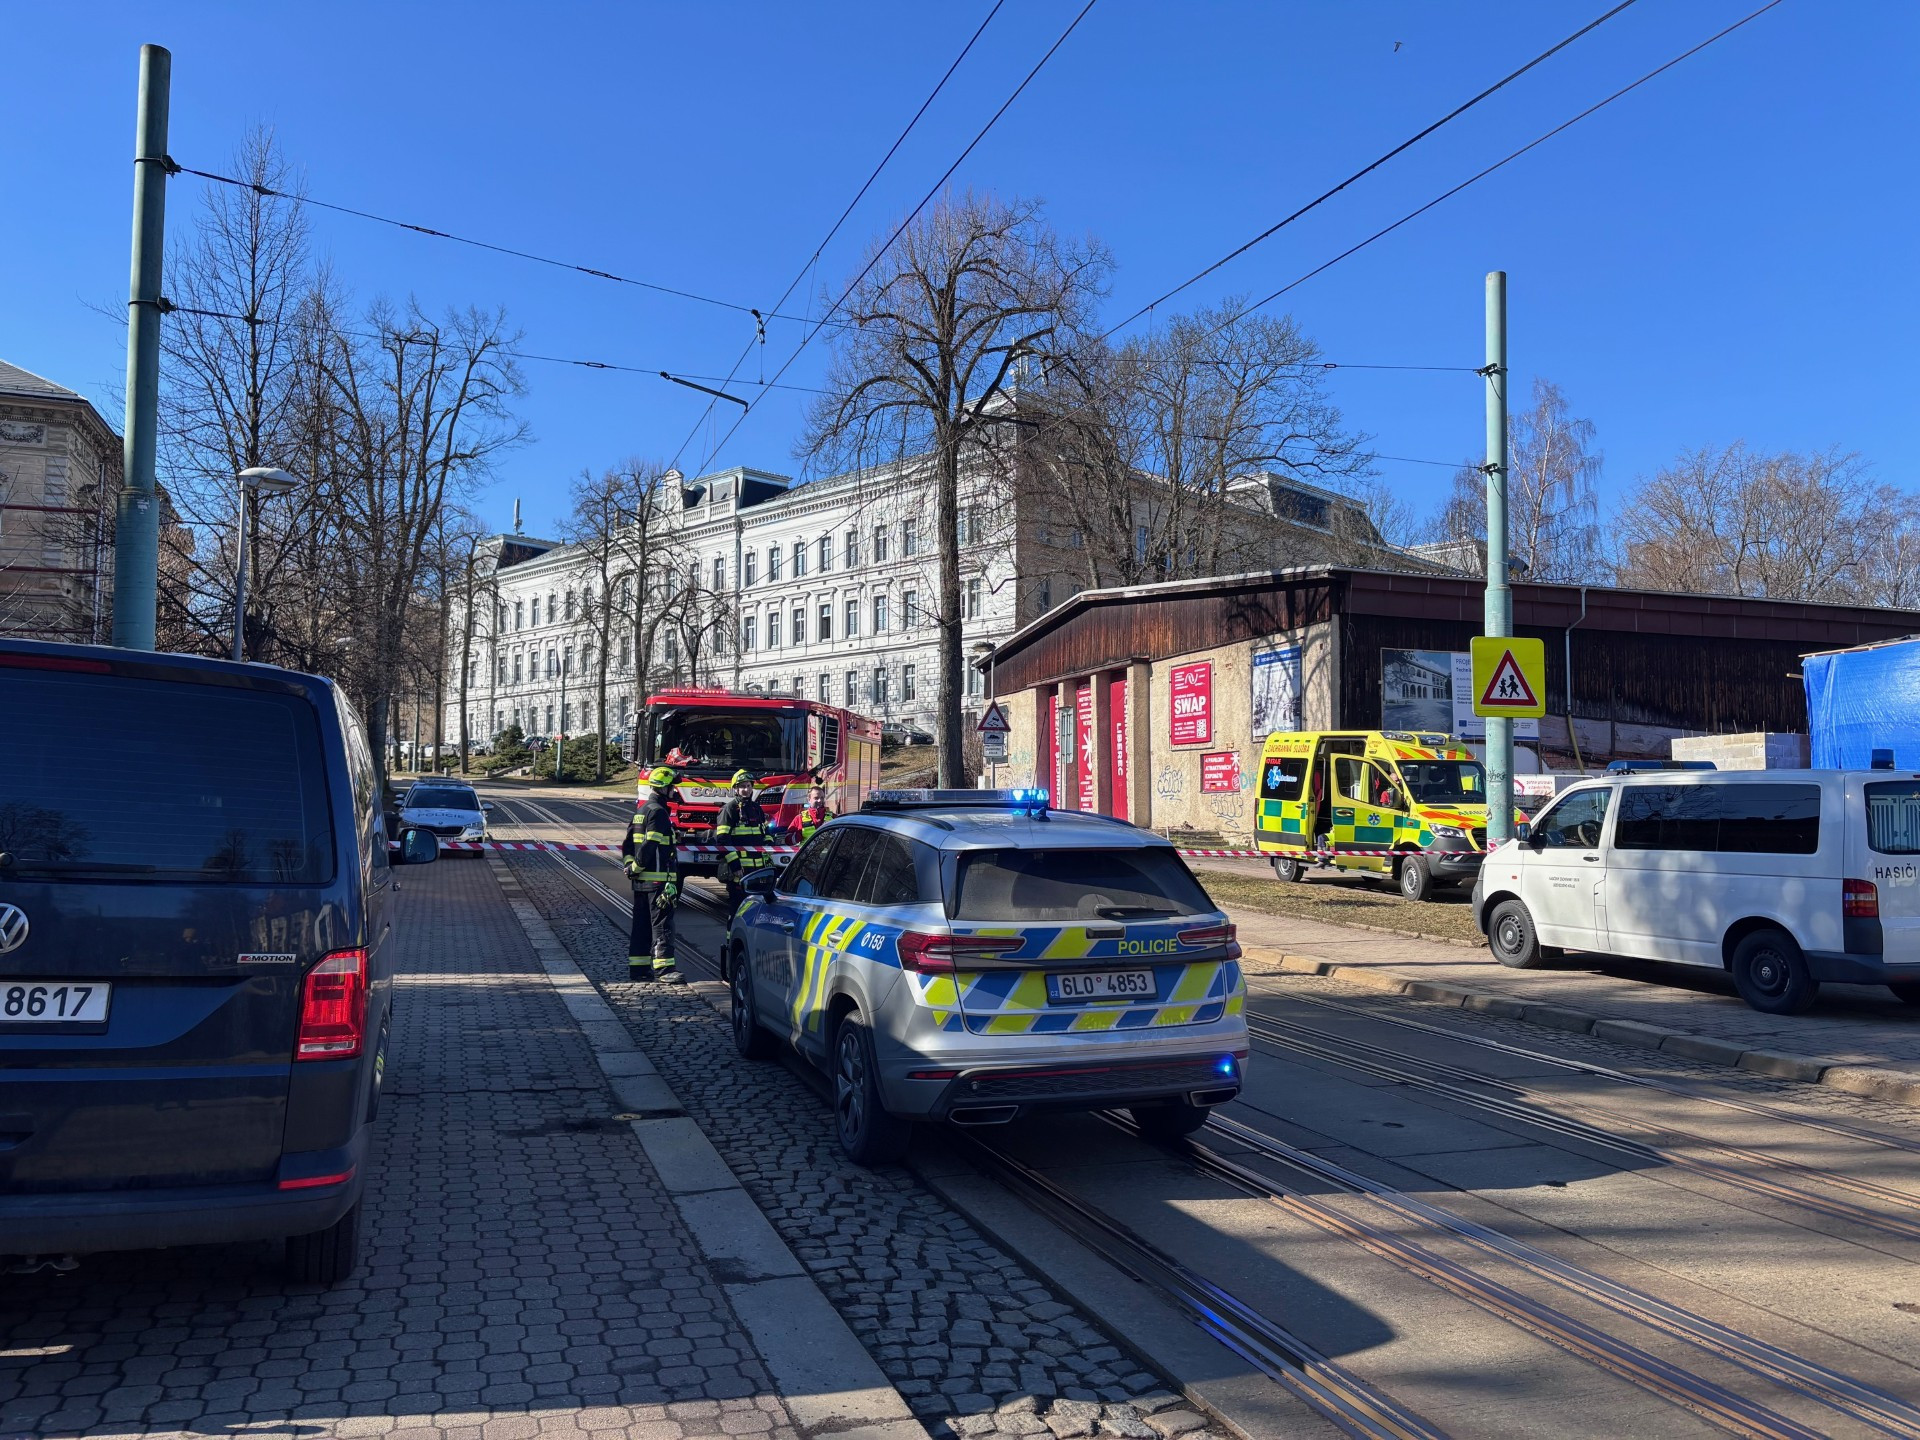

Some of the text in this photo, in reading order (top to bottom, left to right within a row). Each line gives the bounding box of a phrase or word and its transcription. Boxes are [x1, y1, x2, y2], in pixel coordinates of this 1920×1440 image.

[1174, 695, 1206, 715] SWAP
[690, 787, 735, 797] SCAN
[1875, 863, 1917, 879] HASIČI
[868, 934, 885, 950] 158
[1118, 938, 1177, 954] POLICIE
[756, 948, 793, 989] POLICIE
[1062, 974, 1147, 995] 6L0 4853
[4, 986, 93, 1017] 8617
